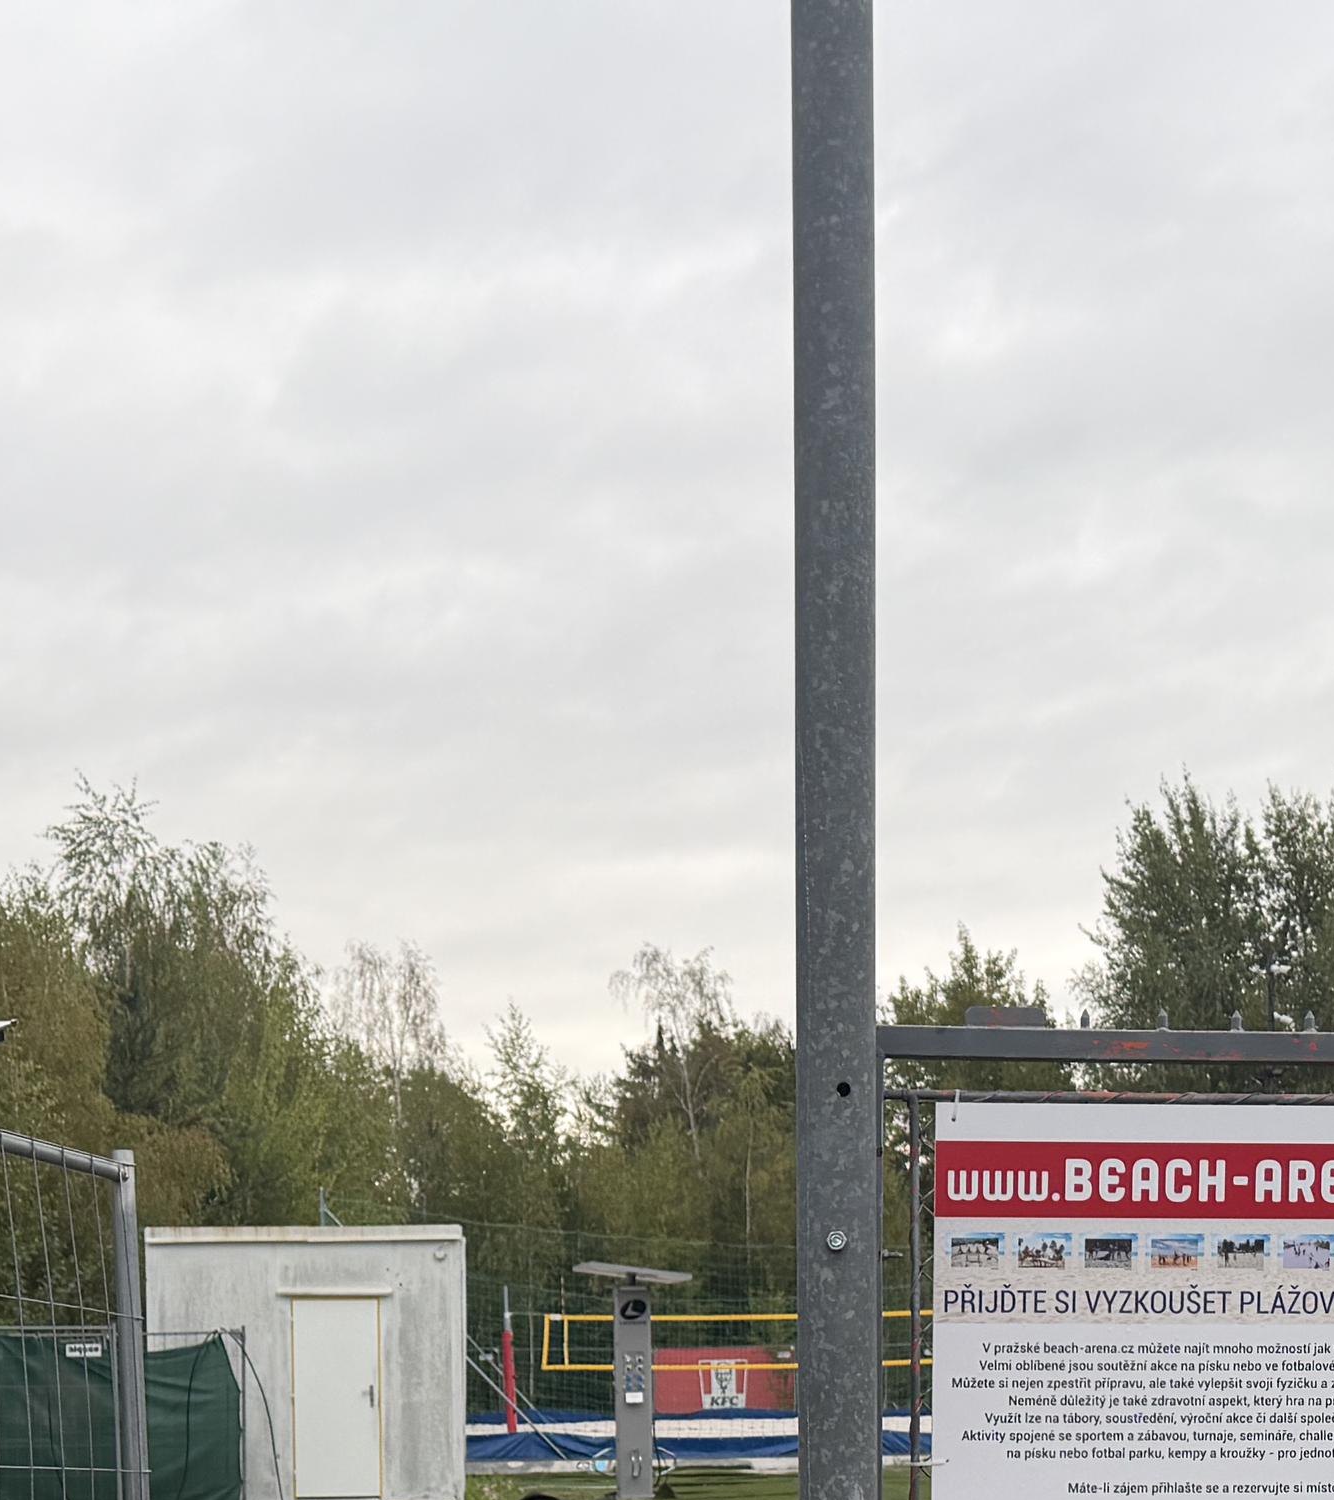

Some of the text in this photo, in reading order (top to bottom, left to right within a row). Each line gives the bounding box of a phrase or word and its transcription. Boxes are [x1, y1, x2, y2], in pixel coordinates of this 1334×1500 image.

[944, 1284, 1047, 1313] PŘIJĎTE
[1054, 1290, 1076, 1313] SI
[1084, 1285, 1232, 1314] VYZKOUŠET
[982, 1343, 991, 1353] V
[993, 1342, 1041, 1356] pražské
[1043, 1342, 1135, 1353] beach-arena.cz
[1137, 1343, 1181, 1353] můžete
[1183, 1343, 1210, 1356] najít
[1212, 1343, 1254, 1353] mnoho
[1256, 1343, 1311, 1353] možností
[1312, 1343, 1331, 1356] jak
[978, 1360, 1012, 1370] Velmi
[1015, 1360, 1066, 1371] oblíbené
[1067, 1360, 1094, 1373] jsou
[1097, 1360, 1148, 1371] soutěžní
[1150, 1360, 1178, 1371] akce
[1180, 1363, 1196, 1371] na
[1198, 1360, 1230, 1374] písku
[1232, 1360, 1262, 1371] nebo
[1264, 1363, 1279, 1371] ve
[951, 1377, 995, 1388] Můžete
[998, 1377, 1009, 1388] si
[1011, 1378, 1044, 1391] nejen
[1046, 1377, 1092, 1390] zpestřit
[1094, 1378, 1146, 1391] přípravu,
[1148, 1377, 1167, 1388] ale
[1169, 1377, 1195, 1388] také
[1197, 1378, 1243, 1391] vylepšit
[1245, 1378, 1273, 1391] svoji
[1276, 1377, 1318, 1391] fyzičku
[710, 1396, 739, 1406] KFC
[1008, 1395, 1057, 1406] Neméně
[1059, 1395, 1106, 1408] důležitý
[1108, 1395, 1120, 1408] je
[1122, 1395, 1148, 1406] také
[1150, 1395, 1206, 1406] zdravotní
[1208, 1395, 1251, 1408] aspekt,
[1253, 1395, 1283, 1408] který
[1285, 1395, 1305, 1406] hra
[1307, 1398, 1322, 1406] na
[984, 1413, 1022, 1426] Využít
[1024, 1413, 1042, 1423] lze
[1044, 1415, 1060, 1423] na
[1062, 1413, 1102, 1426] tábory,
[1105, 1413, 1177, 1424] soustředění,
[1180, 1413, 1224, 1426] výroční
[1225, 1413, 1253, 1423] akce
[1255, 1413, 1266, 1423] či
[1269, 1412, 1298, 1423] další
[1006, 1450, 1021, 1458] na
[1024, 1448, 1056, 1461] písku
[1059, 1448, 1089, 1458] nebo
[1091, 1447, 1126, 1458] fotbal
[1128, 1448, 1165, 1461] parku,
[1167, 1448, 1207, 1461] kempy
[1209, 1450, 1217, 1458] a
[1219, 1447, 1266, 1461] kroužky
[1277, 1450, 1297, 1460] pro
[1067, 1482, 1110, 1493] Máte-li
[1113, 1482, 1148, 1496] zájem
[1151, 1482, 1203, 1496] přihlašte
[1205, 1485, 1220, 1493] se
[1222, 1485, 1230, 1493] a
[1232, 1482, 1290, 1495] rezervujte
[1293, 1482, 1303, 1492] si
